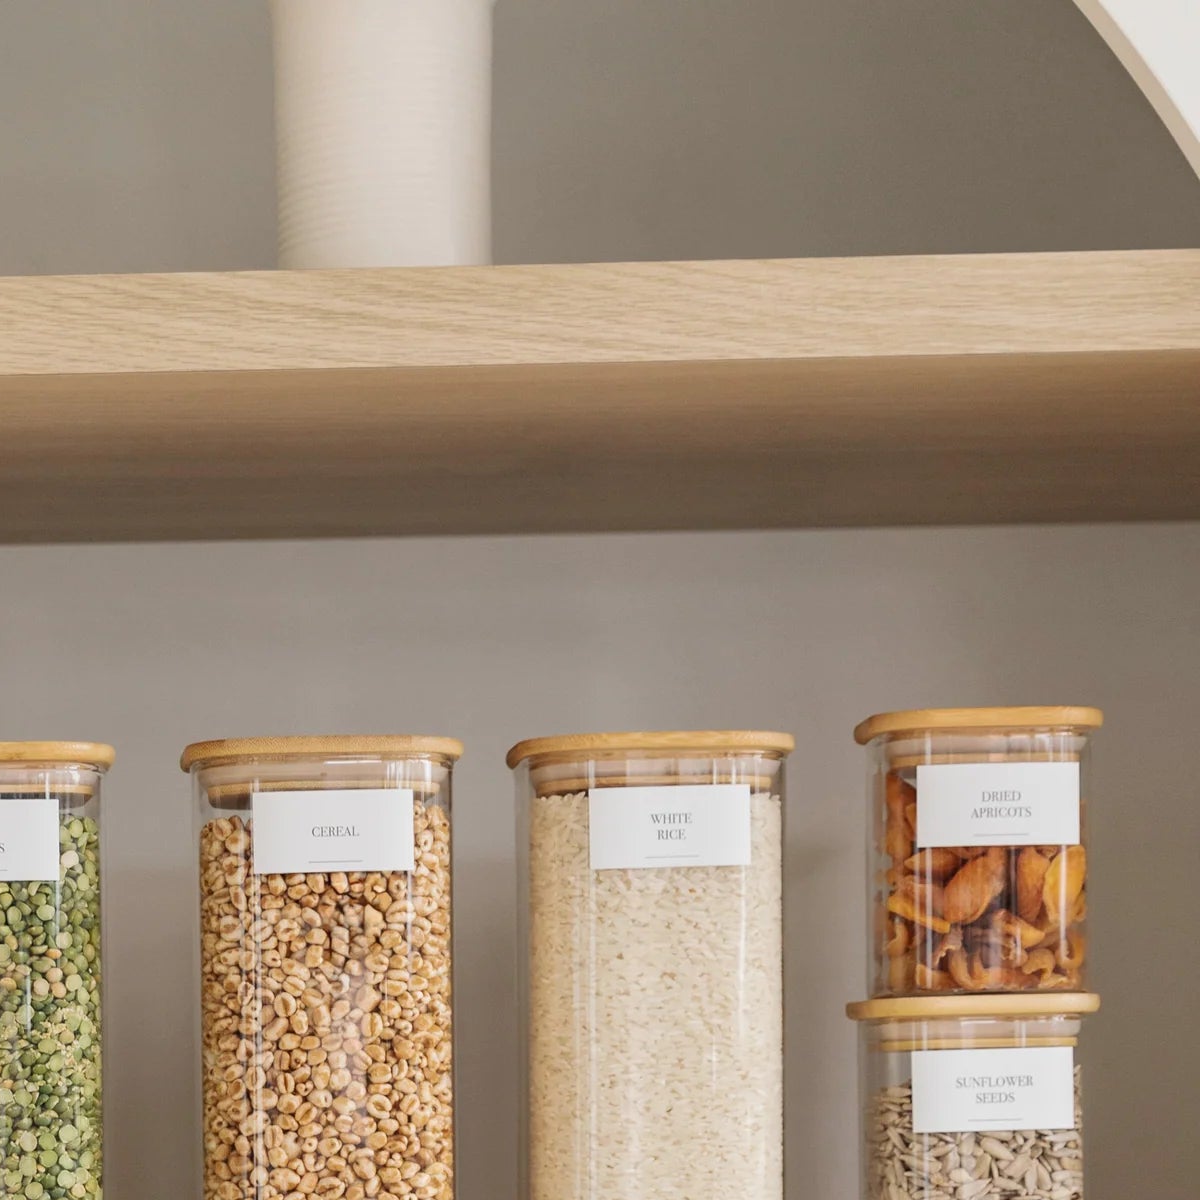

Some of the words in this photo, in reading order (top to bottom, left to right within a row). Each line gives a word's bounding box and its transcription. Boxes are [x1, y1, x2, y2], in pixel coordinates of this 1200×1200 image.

[981, 790, 1022, 803] DRIED
[650, 813, 693, 825] WHITE
[970, 807, 1032, 819] APRICOTS
[311, 826, 360, 838] CEREAL
[657, 829, 687, 841] RICE
[955, 1075, 1034, 1089] SUNFLOWER
[975, 1092, 1016, 1105] SEEDS
